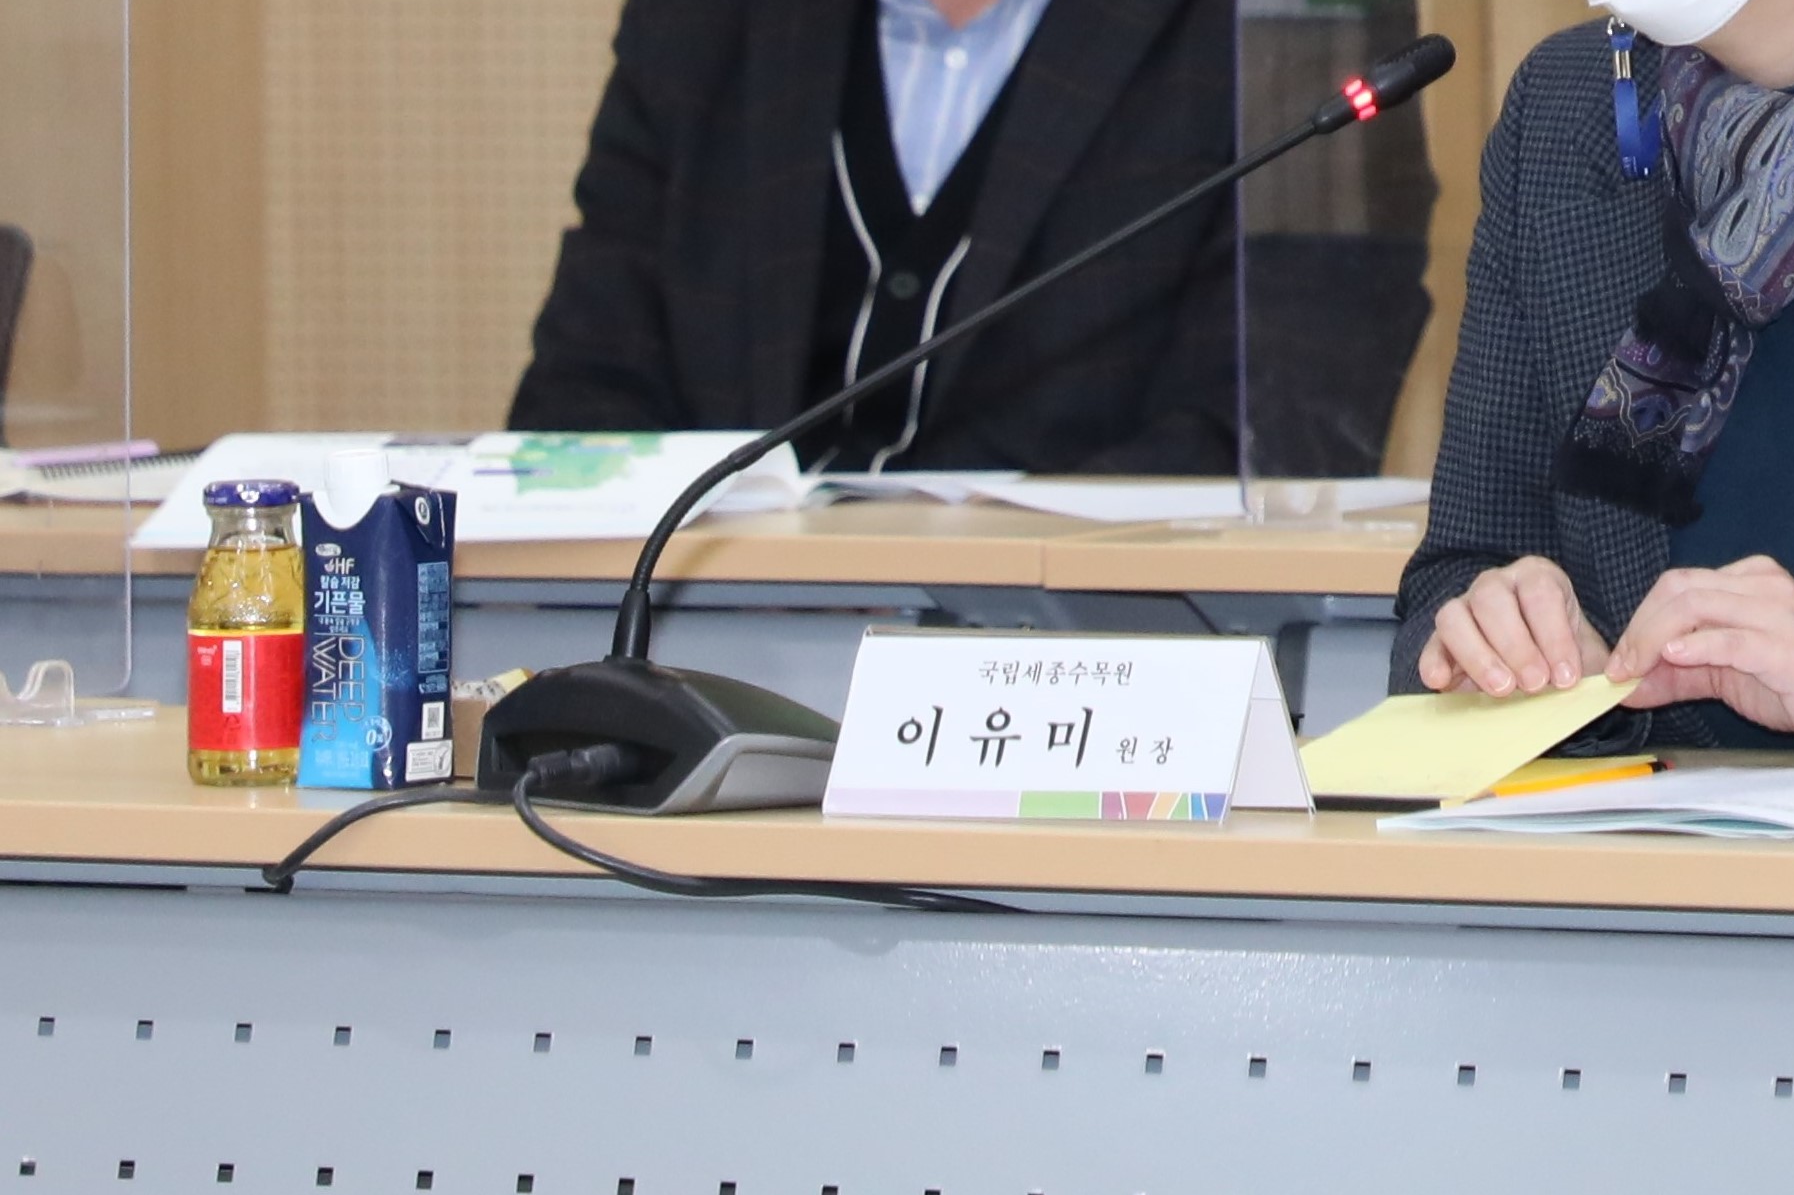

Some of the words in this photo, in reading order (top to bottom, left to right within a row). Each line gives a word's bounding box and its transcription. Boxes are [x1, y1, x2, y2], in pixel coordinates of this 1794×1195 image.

[335, 557, 355, 575] HF
[314, 591, 366, 615] 기픈물
[338, 636, 365, 722] DEEP
[979, 660, 1134, 686] 국립세종수목원
[312, 636, 336, 742] WATER
